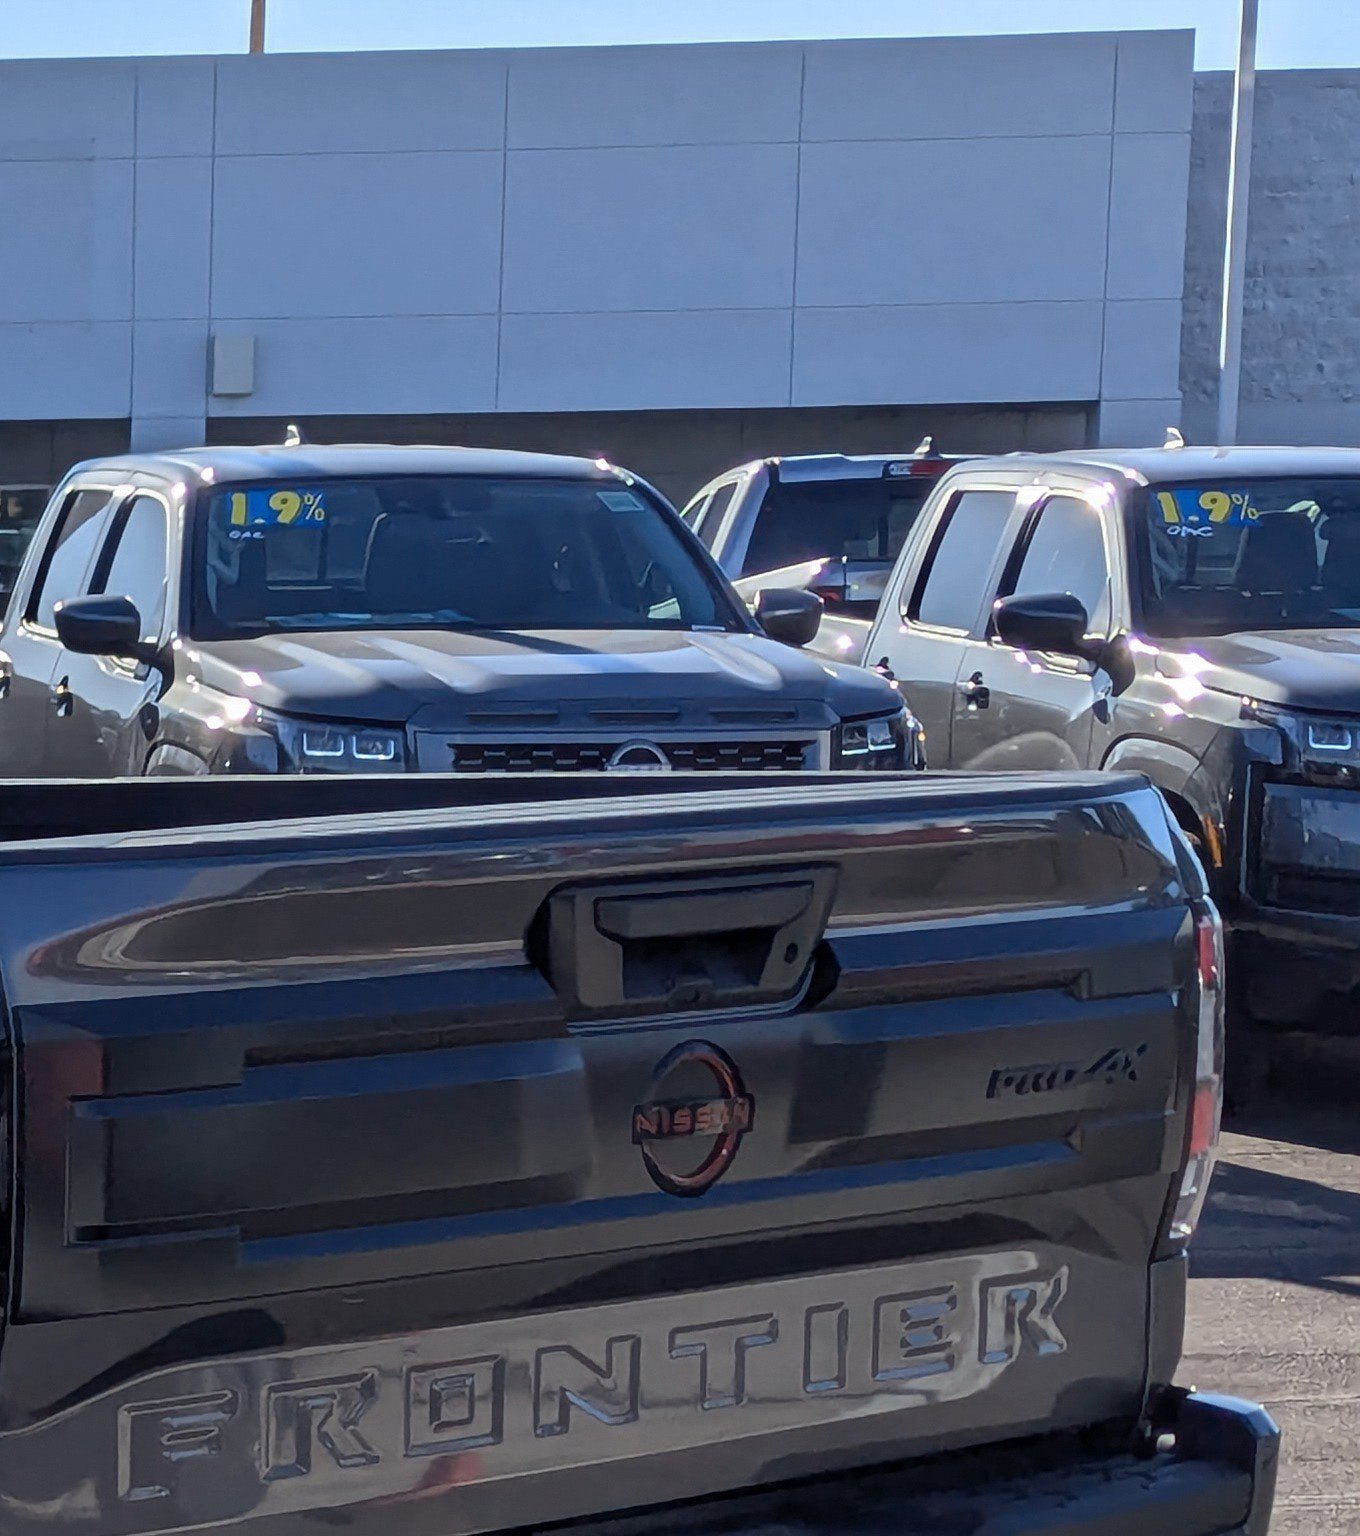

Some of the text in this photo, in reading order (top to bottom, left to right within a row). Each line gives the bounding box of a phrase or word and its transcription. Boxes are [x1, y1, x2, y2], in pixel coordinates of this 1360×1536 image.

[230, 490, 326, 526] 1.9%
[1156, 490, 1260, 524] 1.9%
[116, 1262, 1069, 1502] FRONTIER
